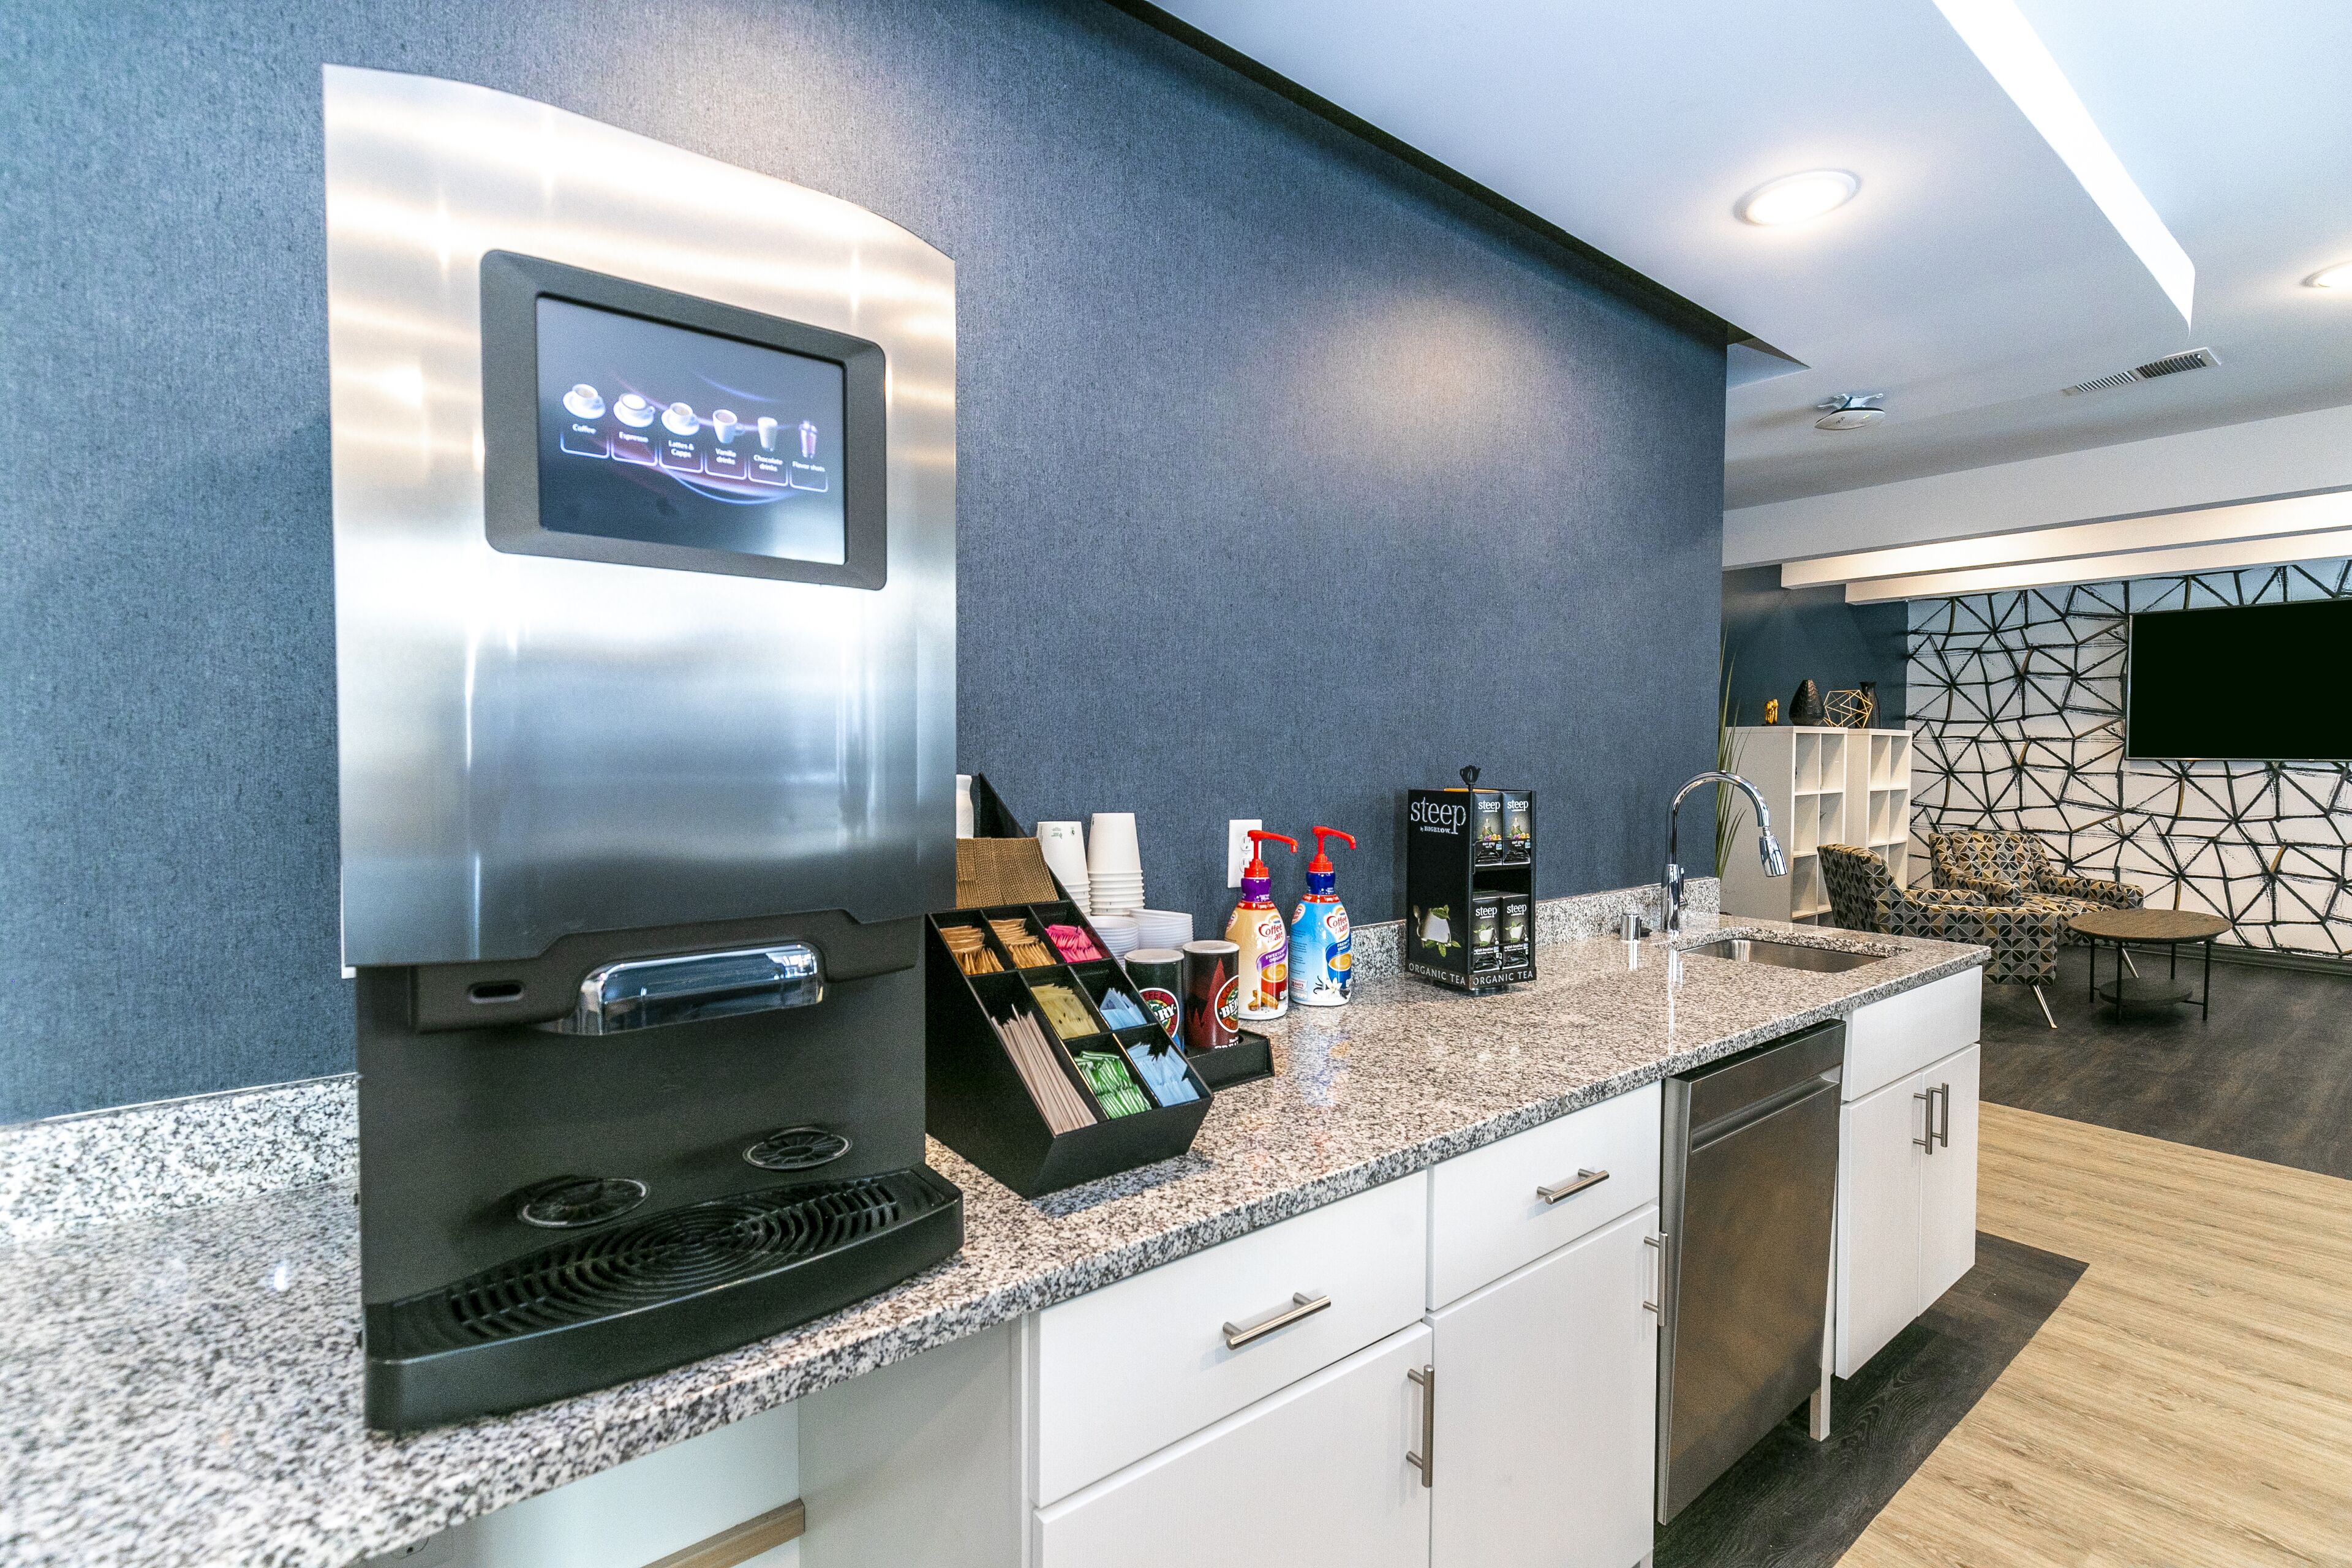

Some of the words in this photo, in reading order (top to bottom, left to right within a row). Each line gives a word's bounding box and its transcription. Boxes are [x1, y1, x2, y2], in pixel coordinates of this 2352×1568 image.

[572, 423, 597, 435] Coffee
[619, 431, 649, 443] Espresso
[715, 447, 737, 458] Vanilla
[716, 456, 736, 466] drinks
[753, 454, 783, 466] Chocolate
[759, 463, 778, 472] drinks
[1478, 800, 1501, 812] steep
[1507, 799, 1529, 812] steep
[1411, 796, 1466, 834] steep
[1476, 907, 1498, 918] steep
[1507, 903, 1527, 915] steep
[1327, 916, 1348, 929] Coffee
[1259, 924, 1282, 937] Coffee
[1409, 962, 1446, 980] ORGANIC
[1450, 973, 1466, 986] TEA
[1473, 973, 1514, 986] ORGANIC
[1517, 970, 1533, 979] TEA
